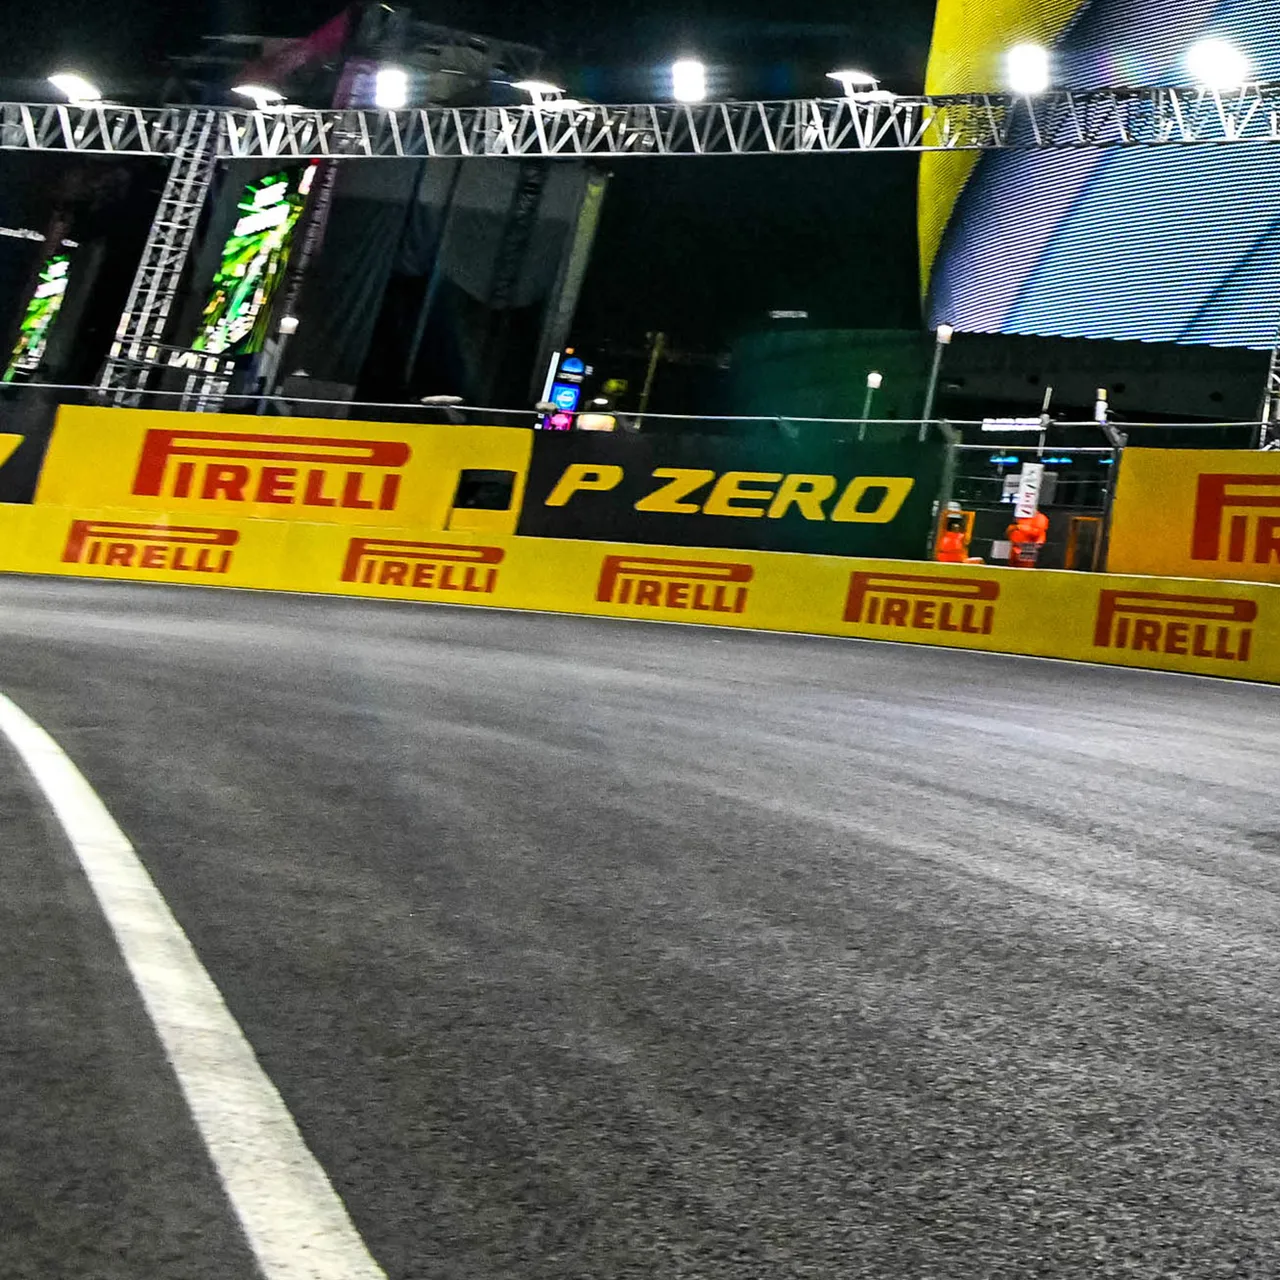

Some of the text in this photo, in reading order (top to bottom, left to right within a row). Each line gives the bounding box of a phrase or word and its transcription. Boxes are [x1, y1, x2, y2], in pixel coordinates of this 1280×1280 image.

[132, 428, 411, 510] PIRELLI
[545, 463, 915, 524] P ZERO
[61, 520, 240, 574] PIRELLI
[340, 537, 505, 593] PIRELLI
[596, 555, 754, 614] PIRELLI
[843, 571, 1000, 635] PIRELLI
[1093, 589, 1258, 663] PIRELLI
